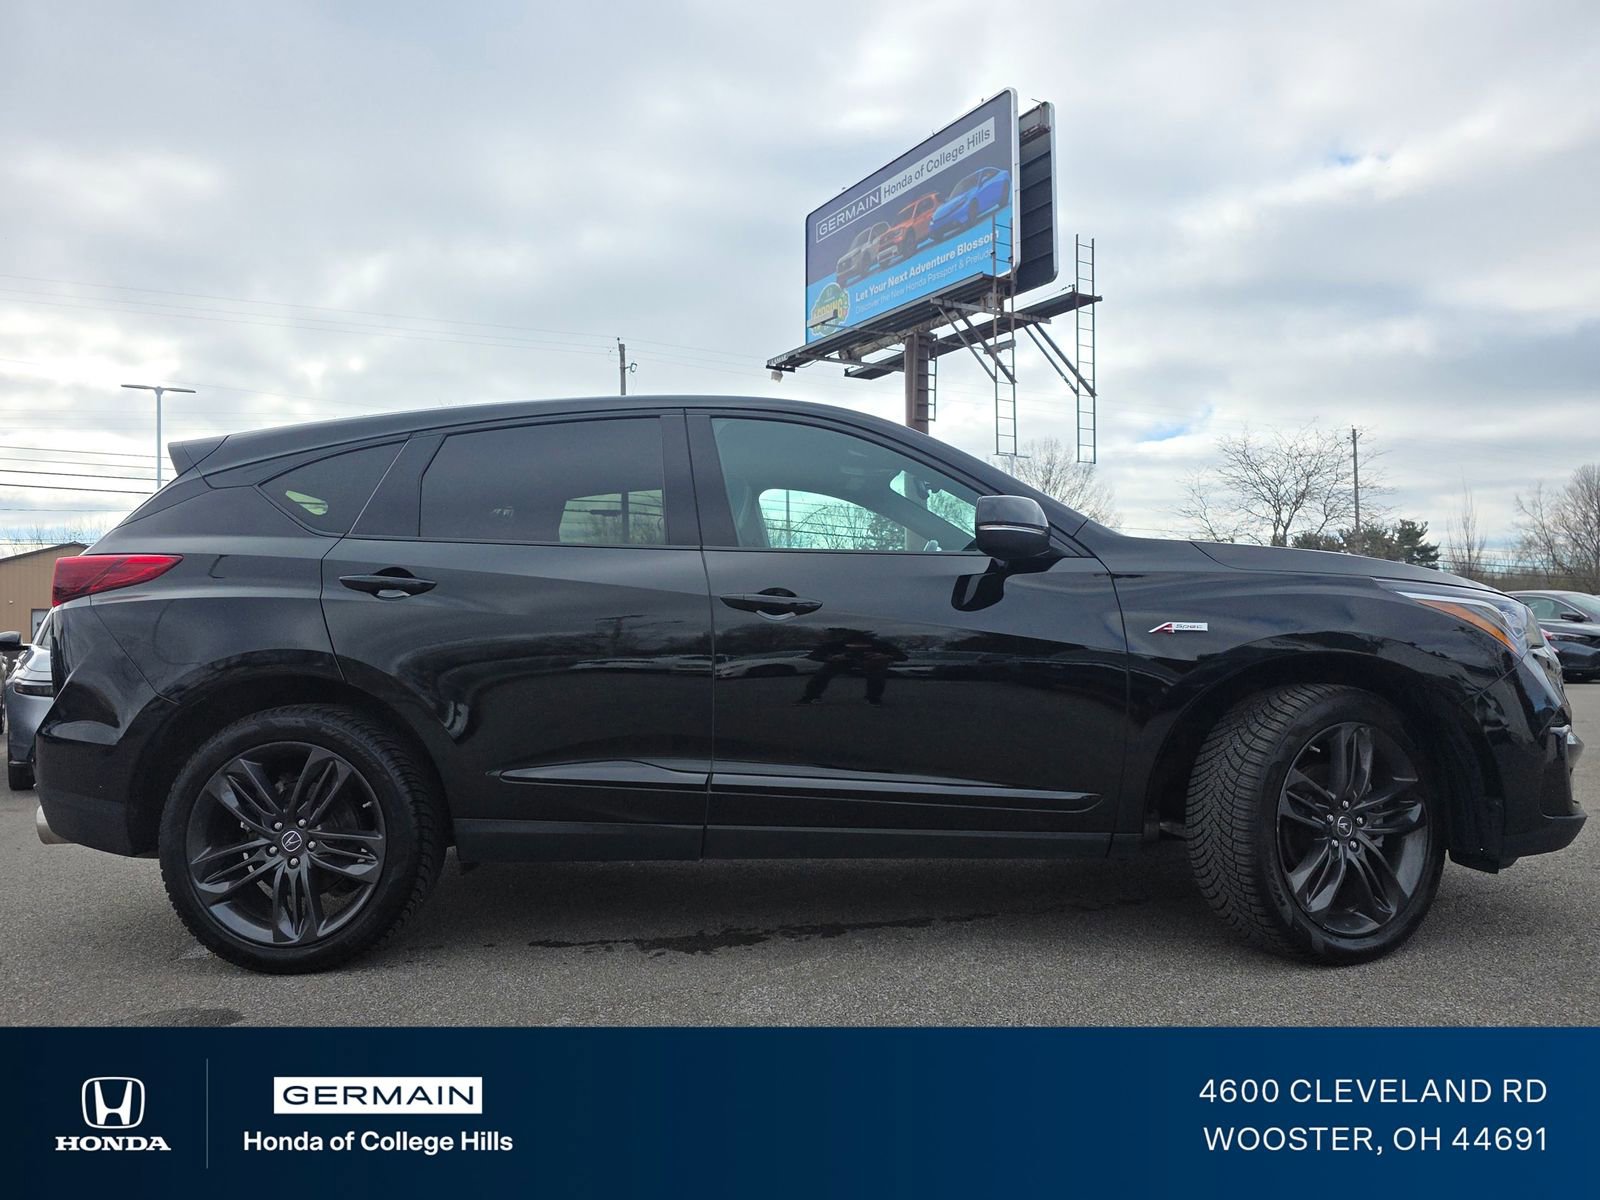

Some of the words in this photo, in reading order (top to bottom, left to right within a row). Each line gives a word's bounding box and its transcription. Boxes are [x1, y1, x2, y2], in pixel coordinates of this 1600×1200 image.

[883, 174, 913, 199] Honda
[914, 165, 924, 180] of
[926, 144, 965, 173] College
[966, 128, 991, 151] Hills
[819, 192, 879, 236] GERMAIN
[855, 289, 868, 302] Let
[869, 281, 887, 296] Your
[888, 271, 908, 288] Next
[908, 250, 955, 278] Adventure
